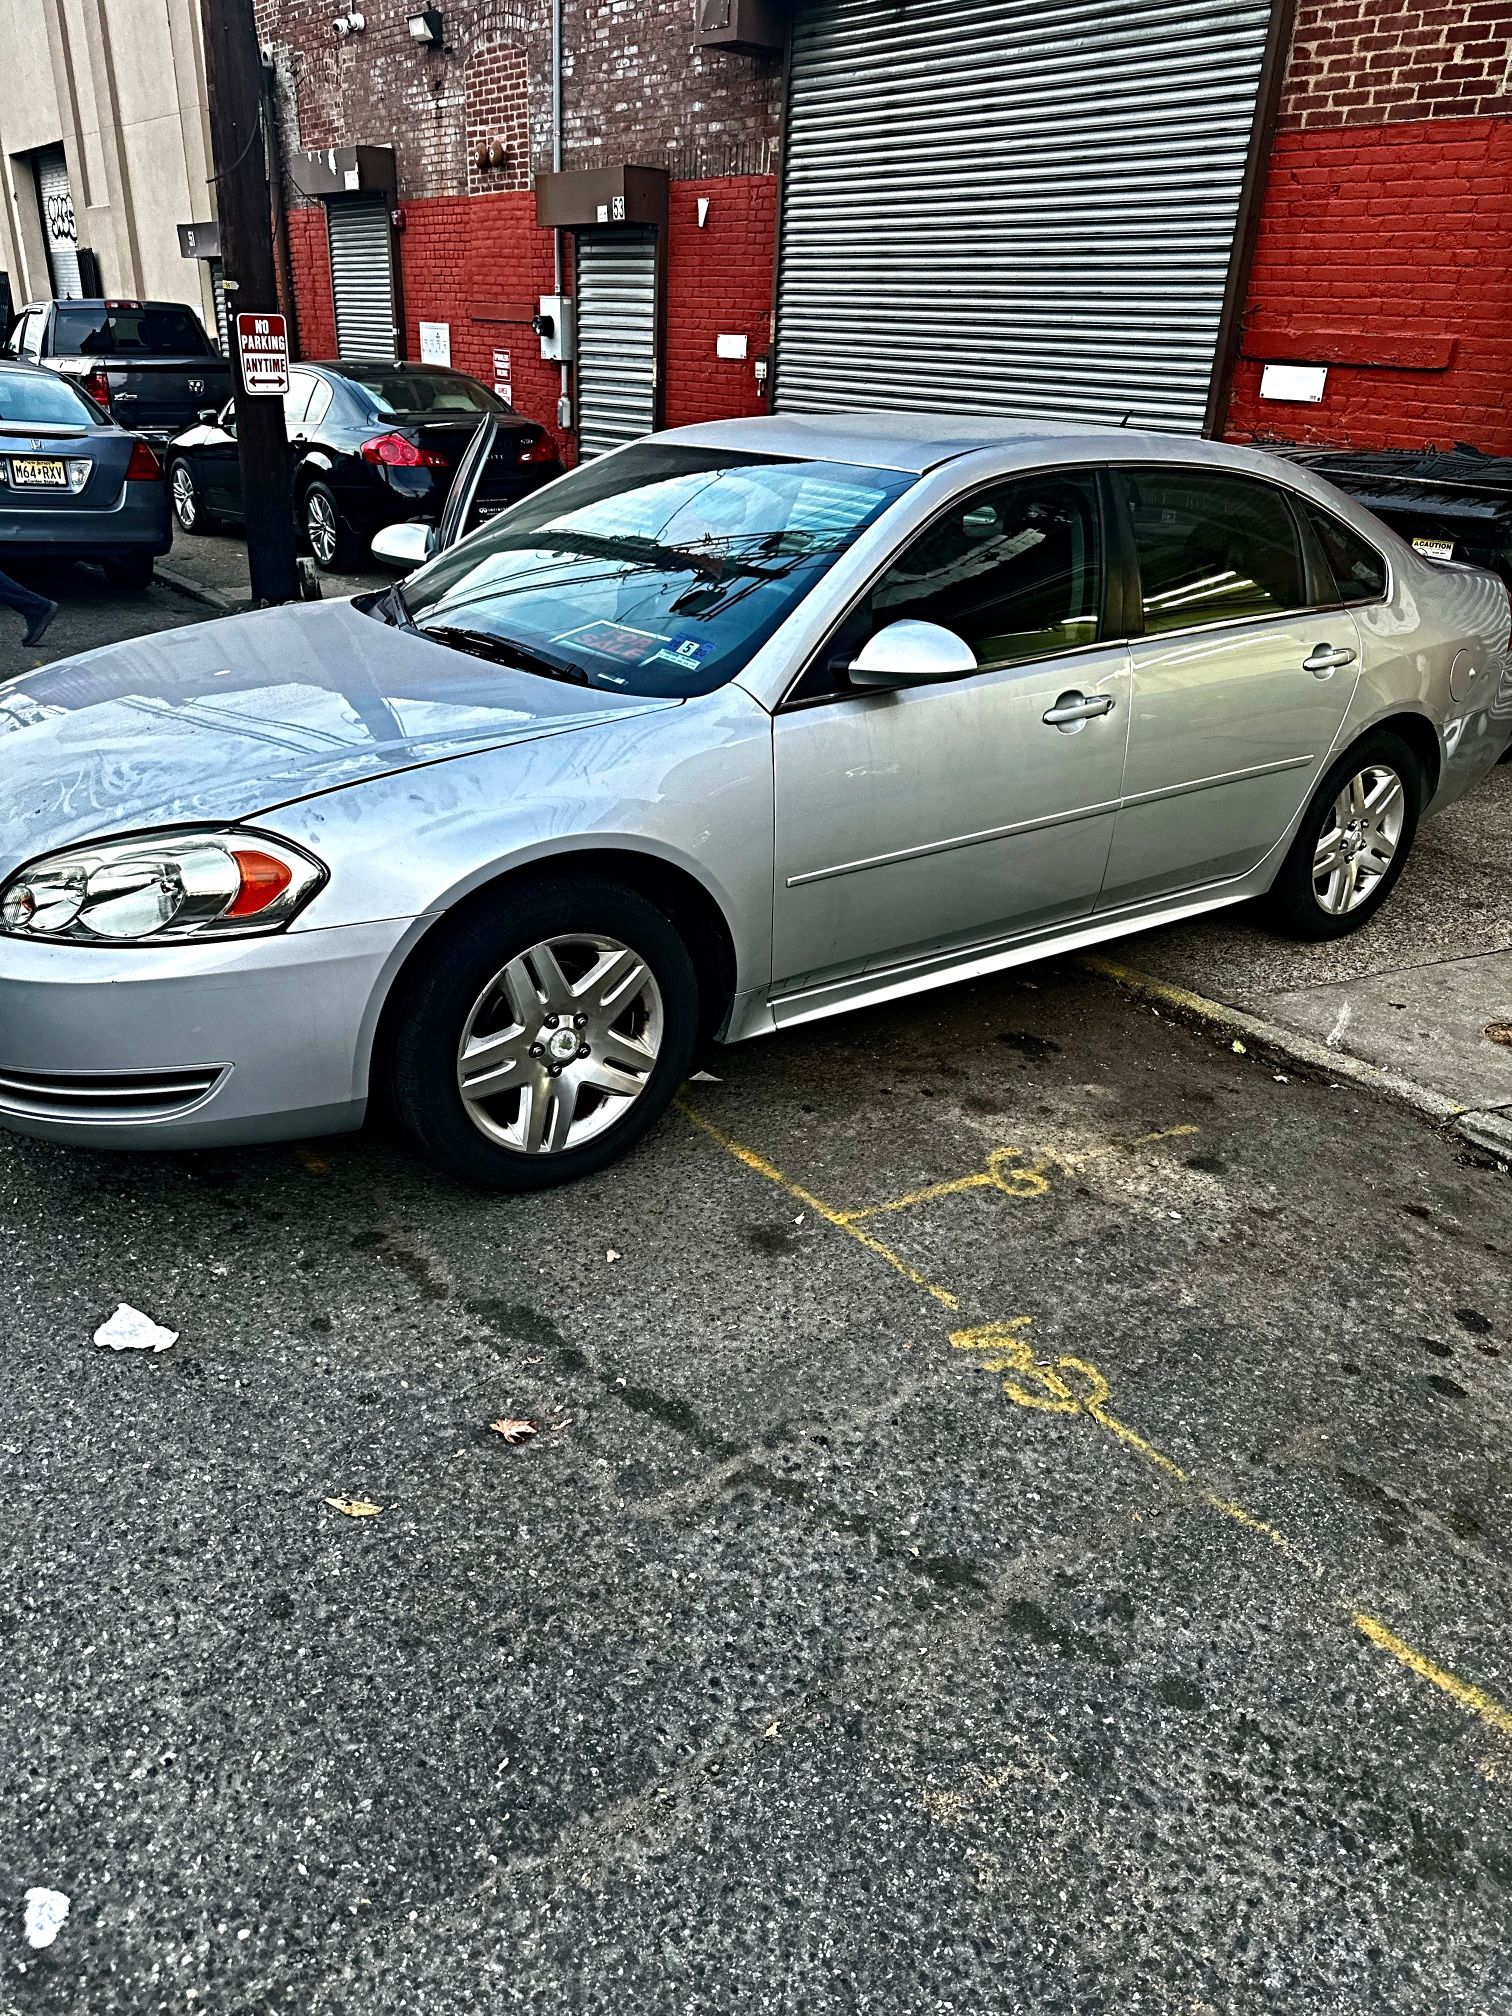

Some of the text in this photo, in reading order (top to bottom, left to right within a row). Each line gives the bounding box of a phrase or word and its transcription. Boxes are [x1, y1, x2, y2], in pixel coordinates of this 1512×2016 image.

[613, 197, 624, 219] 53
[254, 319, 270, 334] NO
[241, 334, 286, 351] PARKING
[245, 357, 286, 373] ANYTIME
[1419, 540, 1452, 551] CAUTION
[574, 633, 648, 660] SALE
[600, 629, 654, 648] FOR
[682, 642, 695, 653] 5
